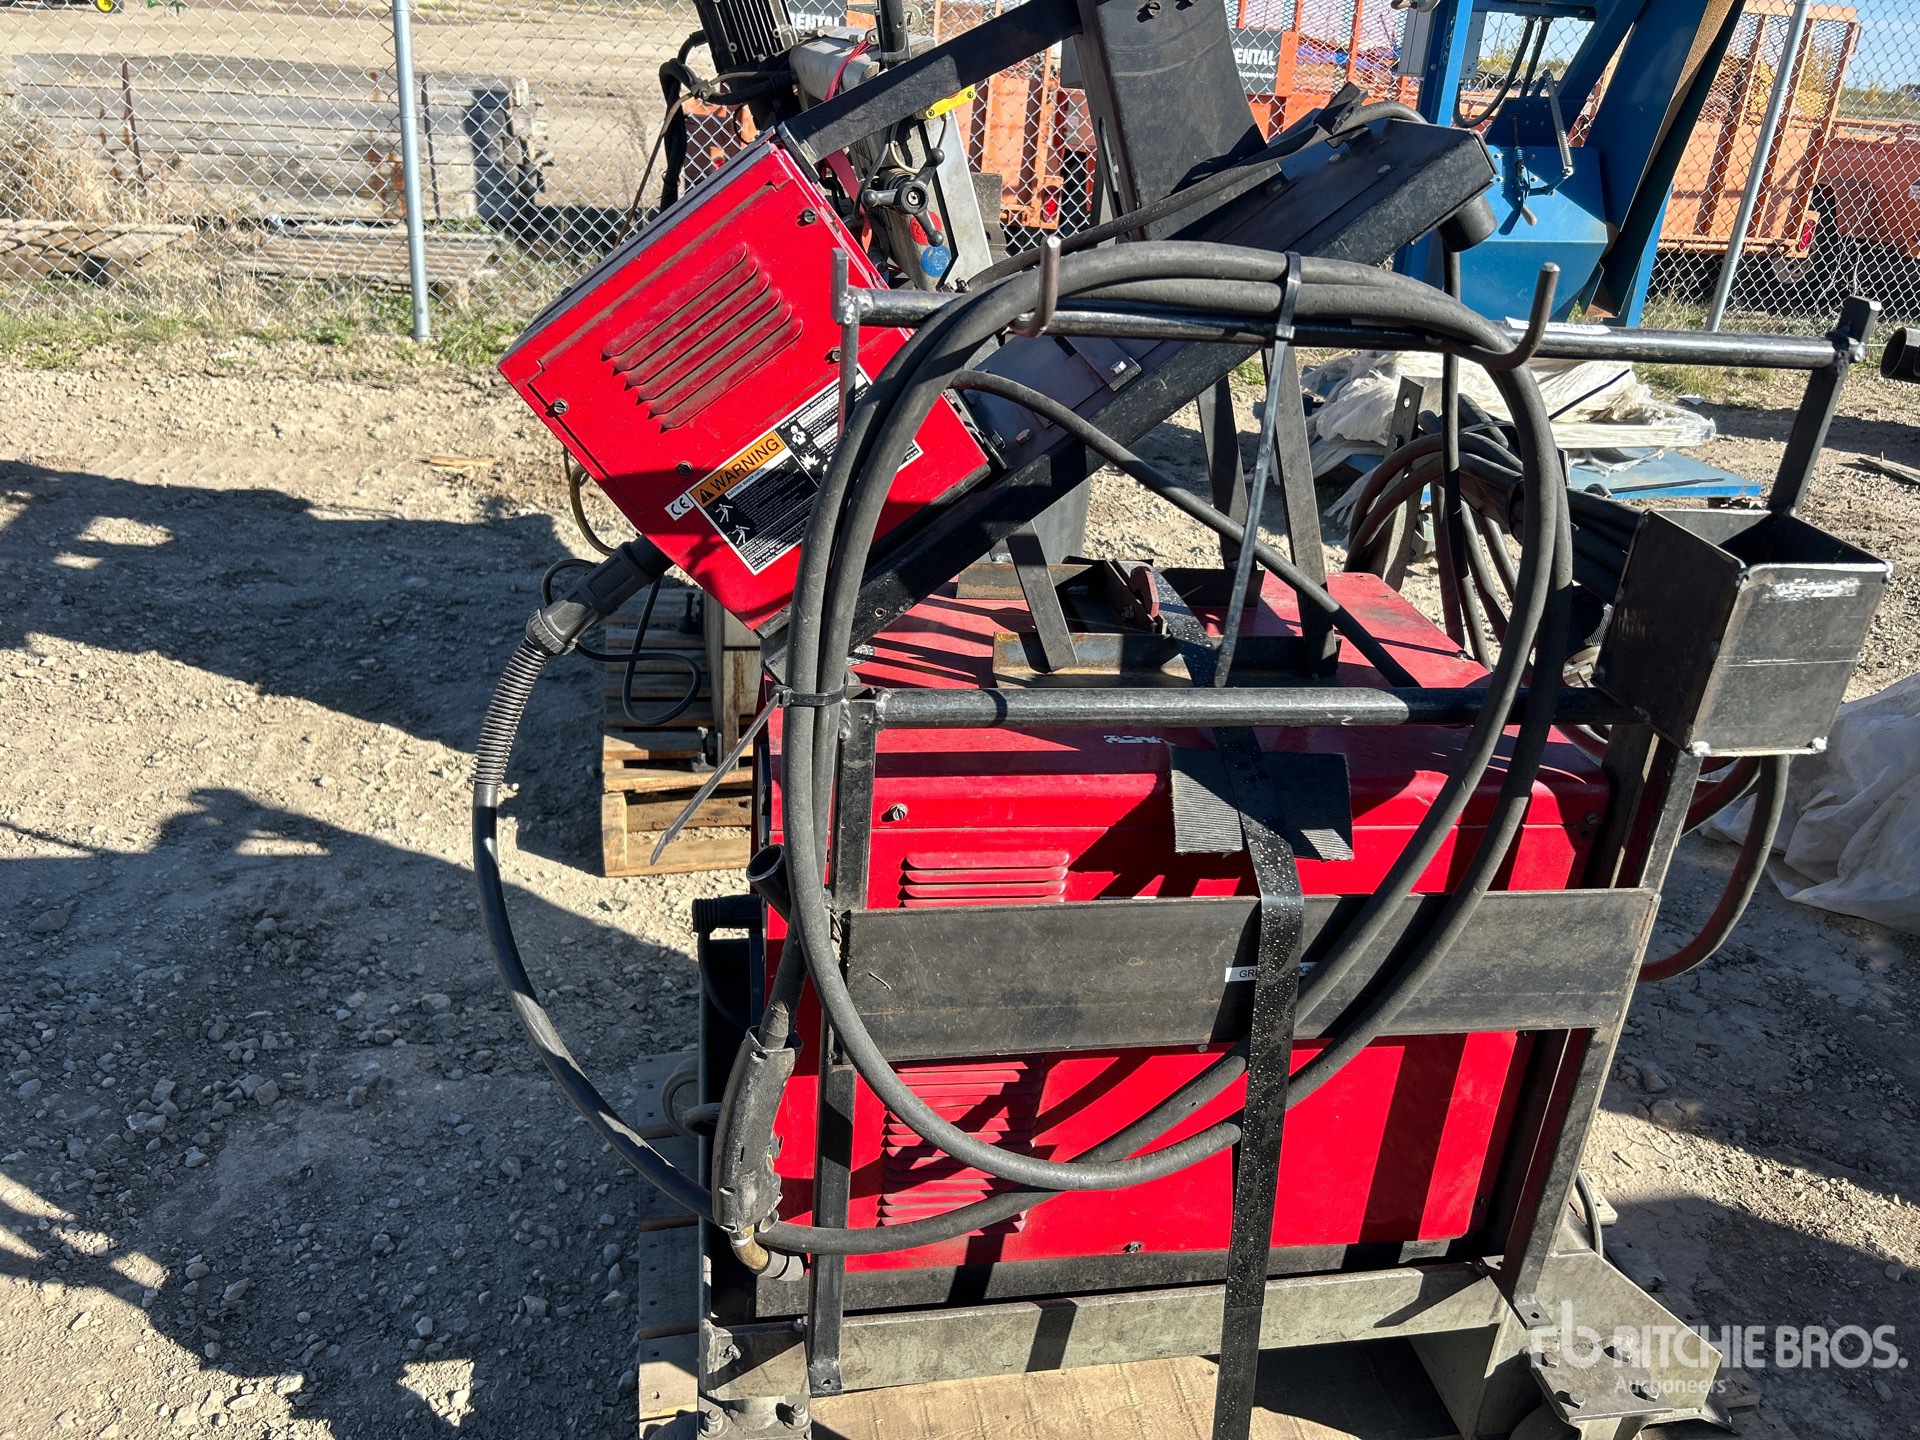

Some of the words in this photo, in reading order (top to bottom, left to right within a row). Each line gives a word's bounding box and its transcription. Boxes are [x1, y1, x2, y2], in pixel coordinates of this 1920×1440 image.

[1233, 47, 1276, 66] ENTAL
[709, 437, 780, 492] WARNING
[671, 497, 690, 516] CE
